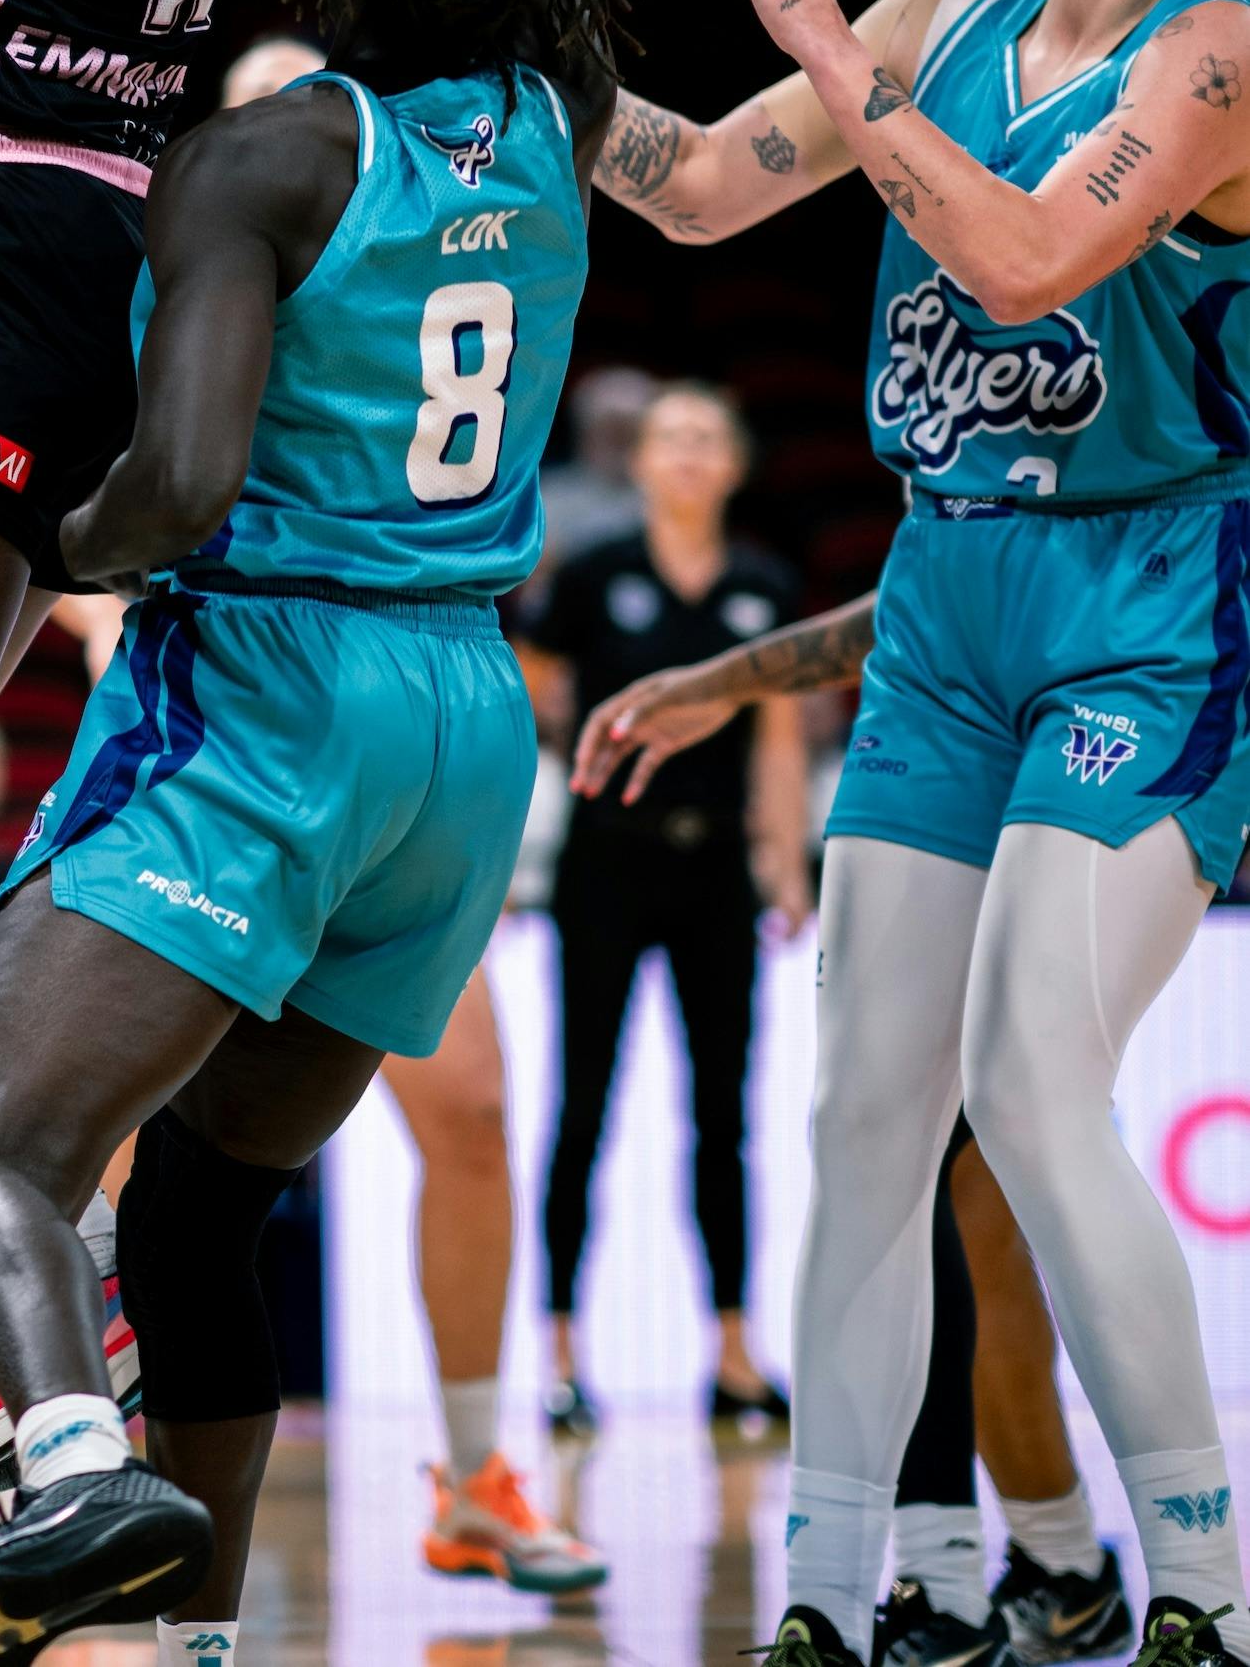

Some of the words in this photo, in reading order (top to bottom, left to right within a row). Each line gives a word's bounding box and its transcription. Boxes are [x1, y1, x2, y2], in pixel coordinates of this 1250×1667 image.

[440, 208, 519, 255] LOK
[406, 280, 517, 511] 8
[880, 290, 1098, 458] Flyers
[1073, 702, 1142, 741] WNBL
